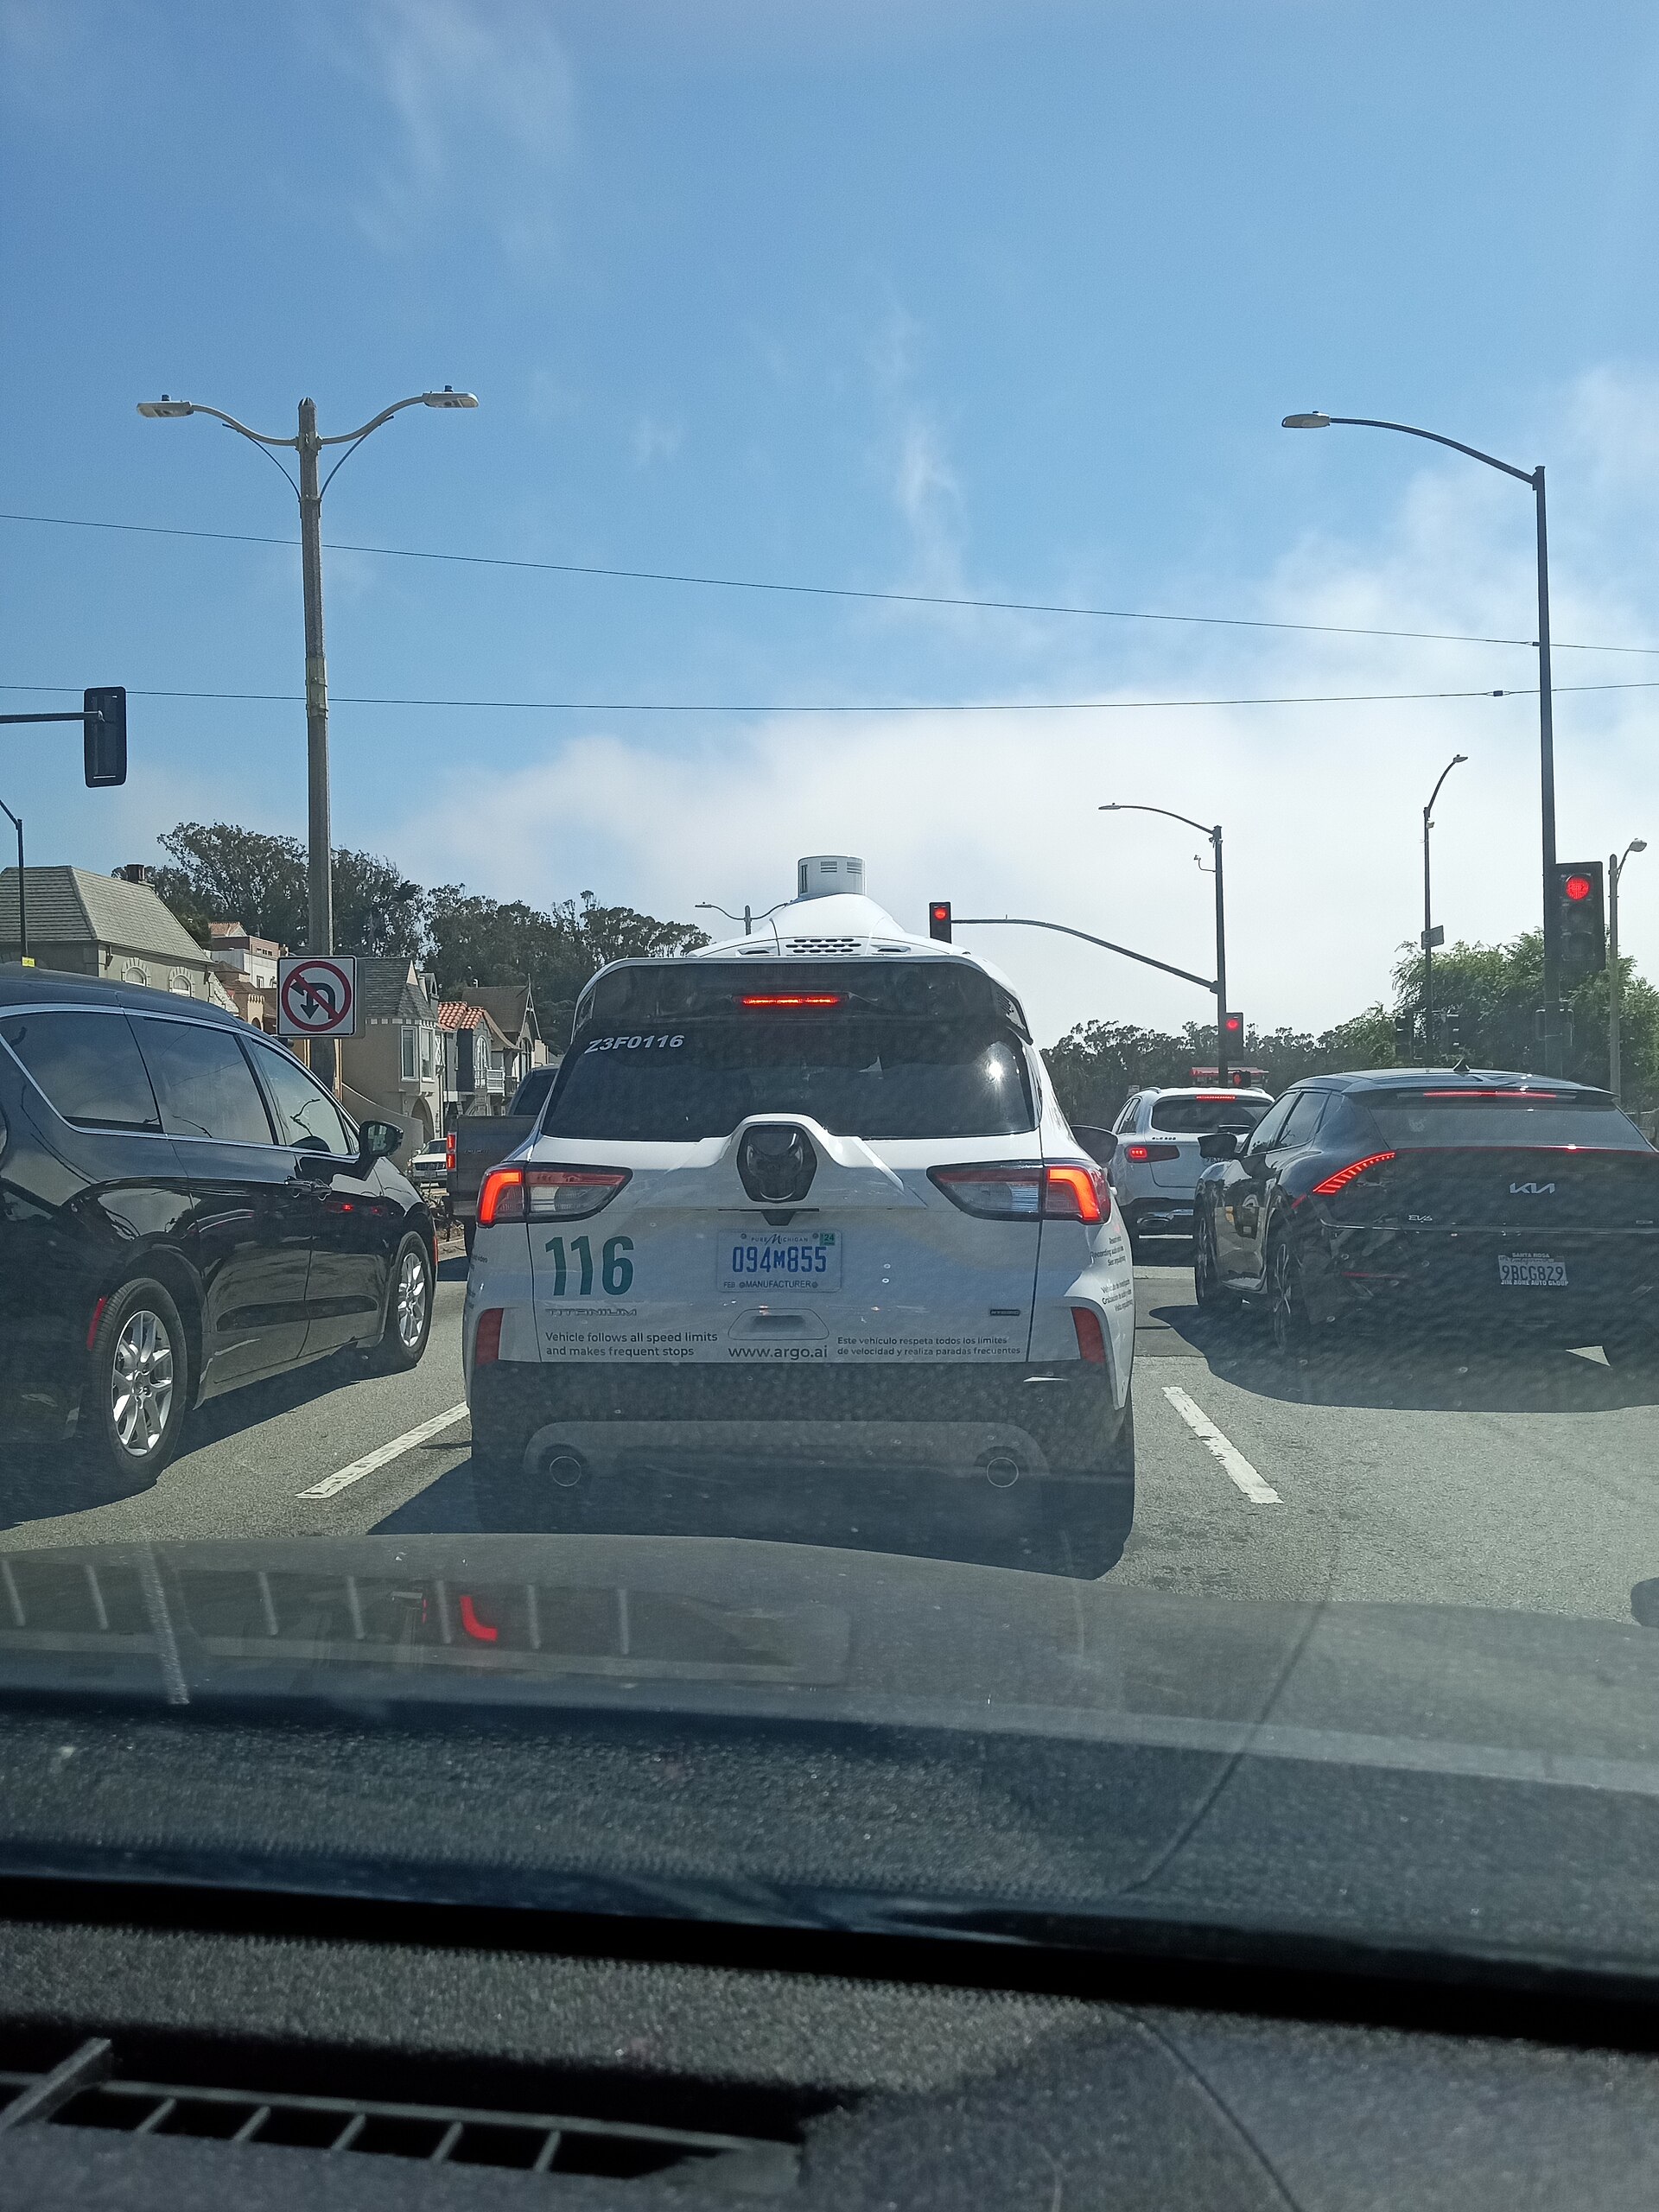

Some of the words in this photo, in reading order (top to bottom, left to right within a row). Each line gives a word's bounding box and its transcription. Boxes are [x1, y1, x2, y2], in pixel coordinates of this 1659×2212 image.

[584, 1035, 685, 1054] Z3F0116
[765, 1233, 809, 1246] MICHIGAN
[545, 1236, 634, 1296] 116
[732, 1246, 827, 1273] 094M855
[1502, 1265, 1564, 1281] 9BCG829
[745, 1280, 811, 1288] MANUFACTURER
[545, 1308, 638, 1317] TITANIUM
[545, 1332, 585, 1342] Vehicle
[587, 1332, 627, 1343] follows
[630, 1332, 644, 1342] all
[646, 1332, 682, 1344] speed
[685, 1331, 718, 1342] limits
[899, 1338, 933, 1346] respeta
[546, 1346, 567, 1356] and
[569, 1346, 606, 1356] makes
[609, 1345, 660, 1357] frequent
[663, 1347, 695, 1357] stops
[728, 1344, 828, 1361] www.argo.ai
[851, 1347, 895, 1356] velocidad
[904, 1347, 933, 1356] realiza
[936, 1347, 971, 1357] paradas
[974, 1346, 1020, 1355] frecuentes
